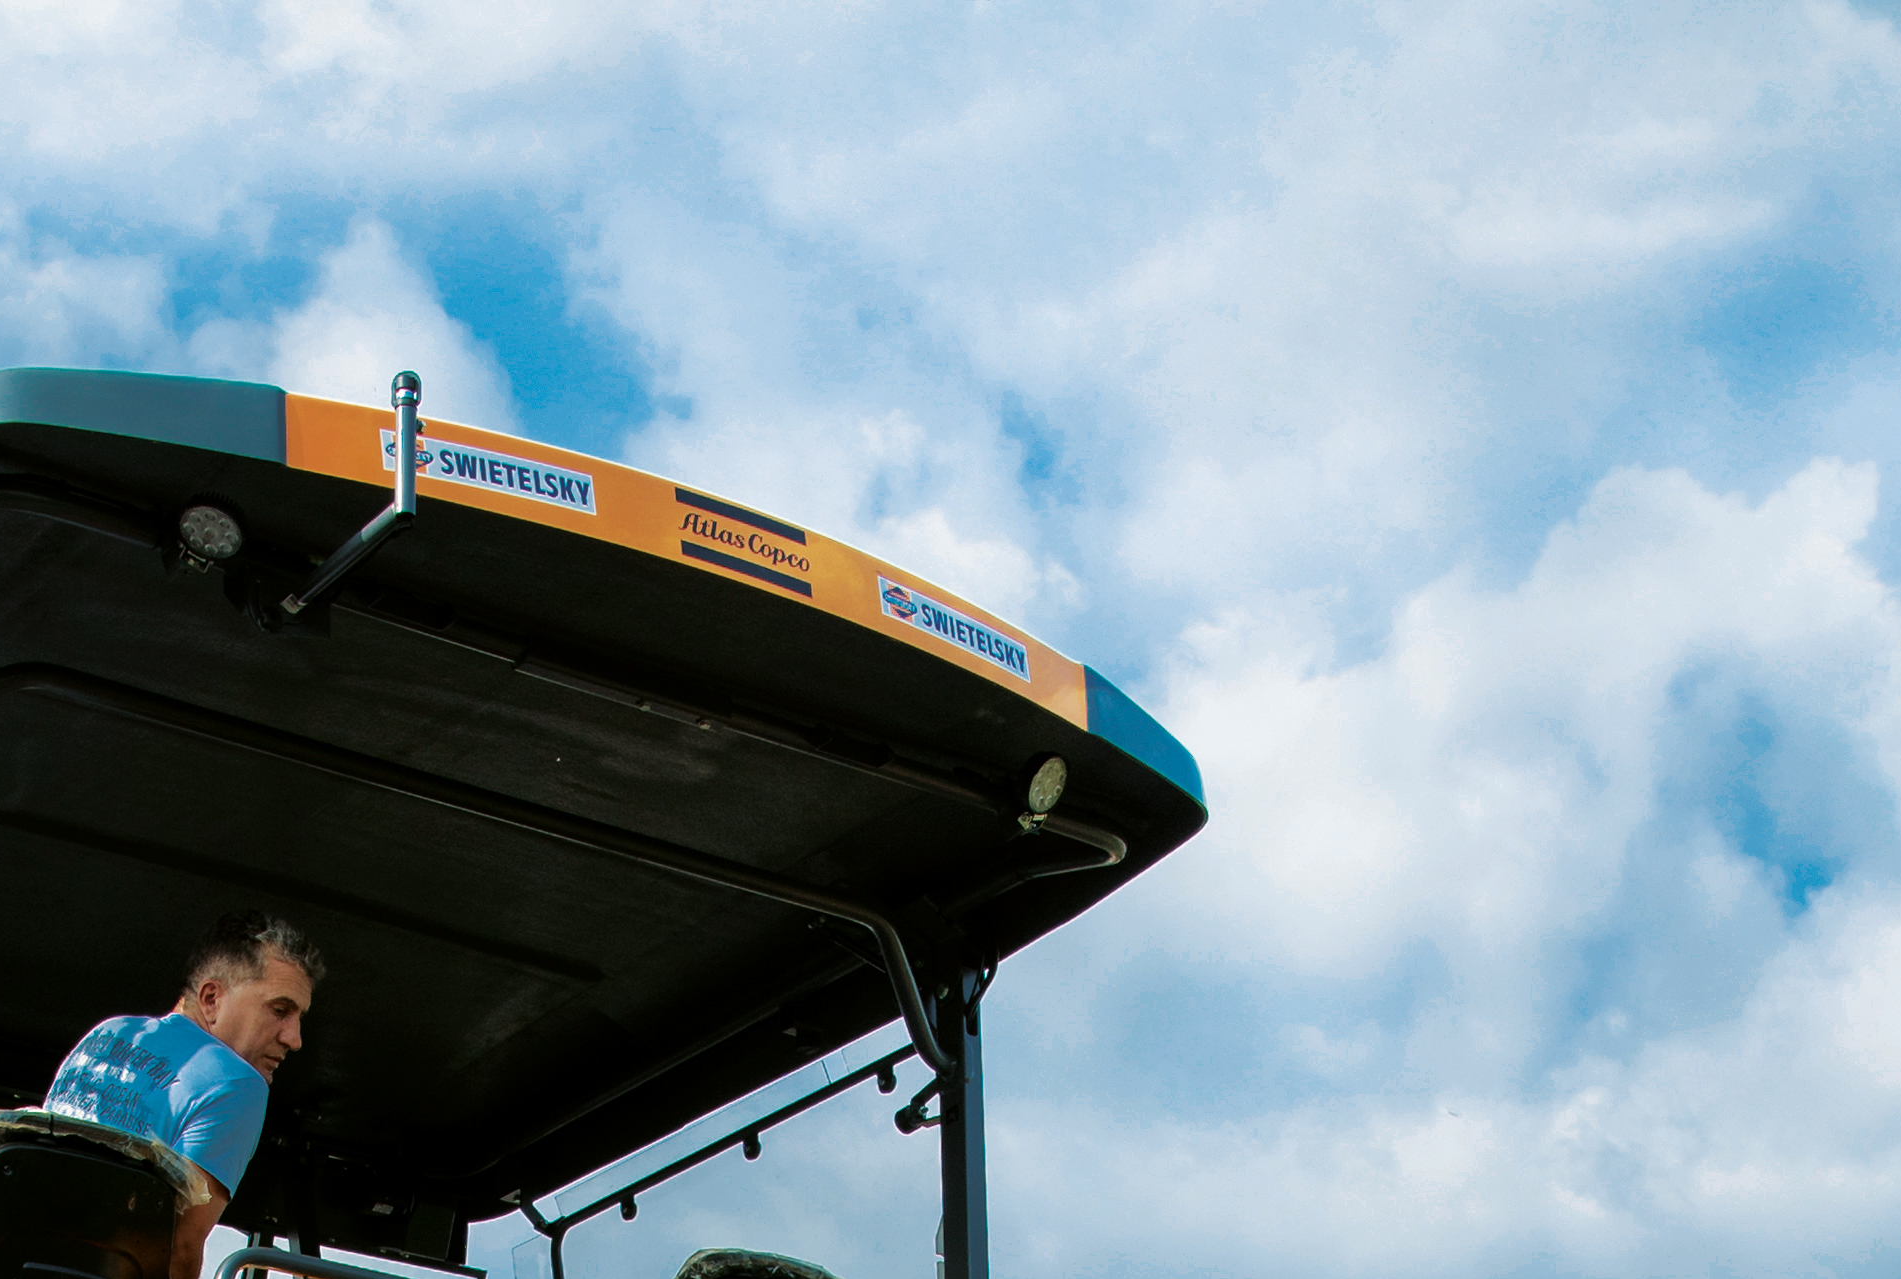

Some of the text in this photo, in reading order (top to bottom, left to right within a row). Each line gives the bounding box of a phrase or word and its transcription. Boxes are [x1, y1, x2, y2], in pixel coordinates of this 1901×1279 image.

[439, 449, 590, 506] SWIETELSKY
[678, 512, 810, 572] Atlas Copco
[921, 603, 1025, 674] SWIETELSKY
[99, 1103, 152, 1137] PARADISE
